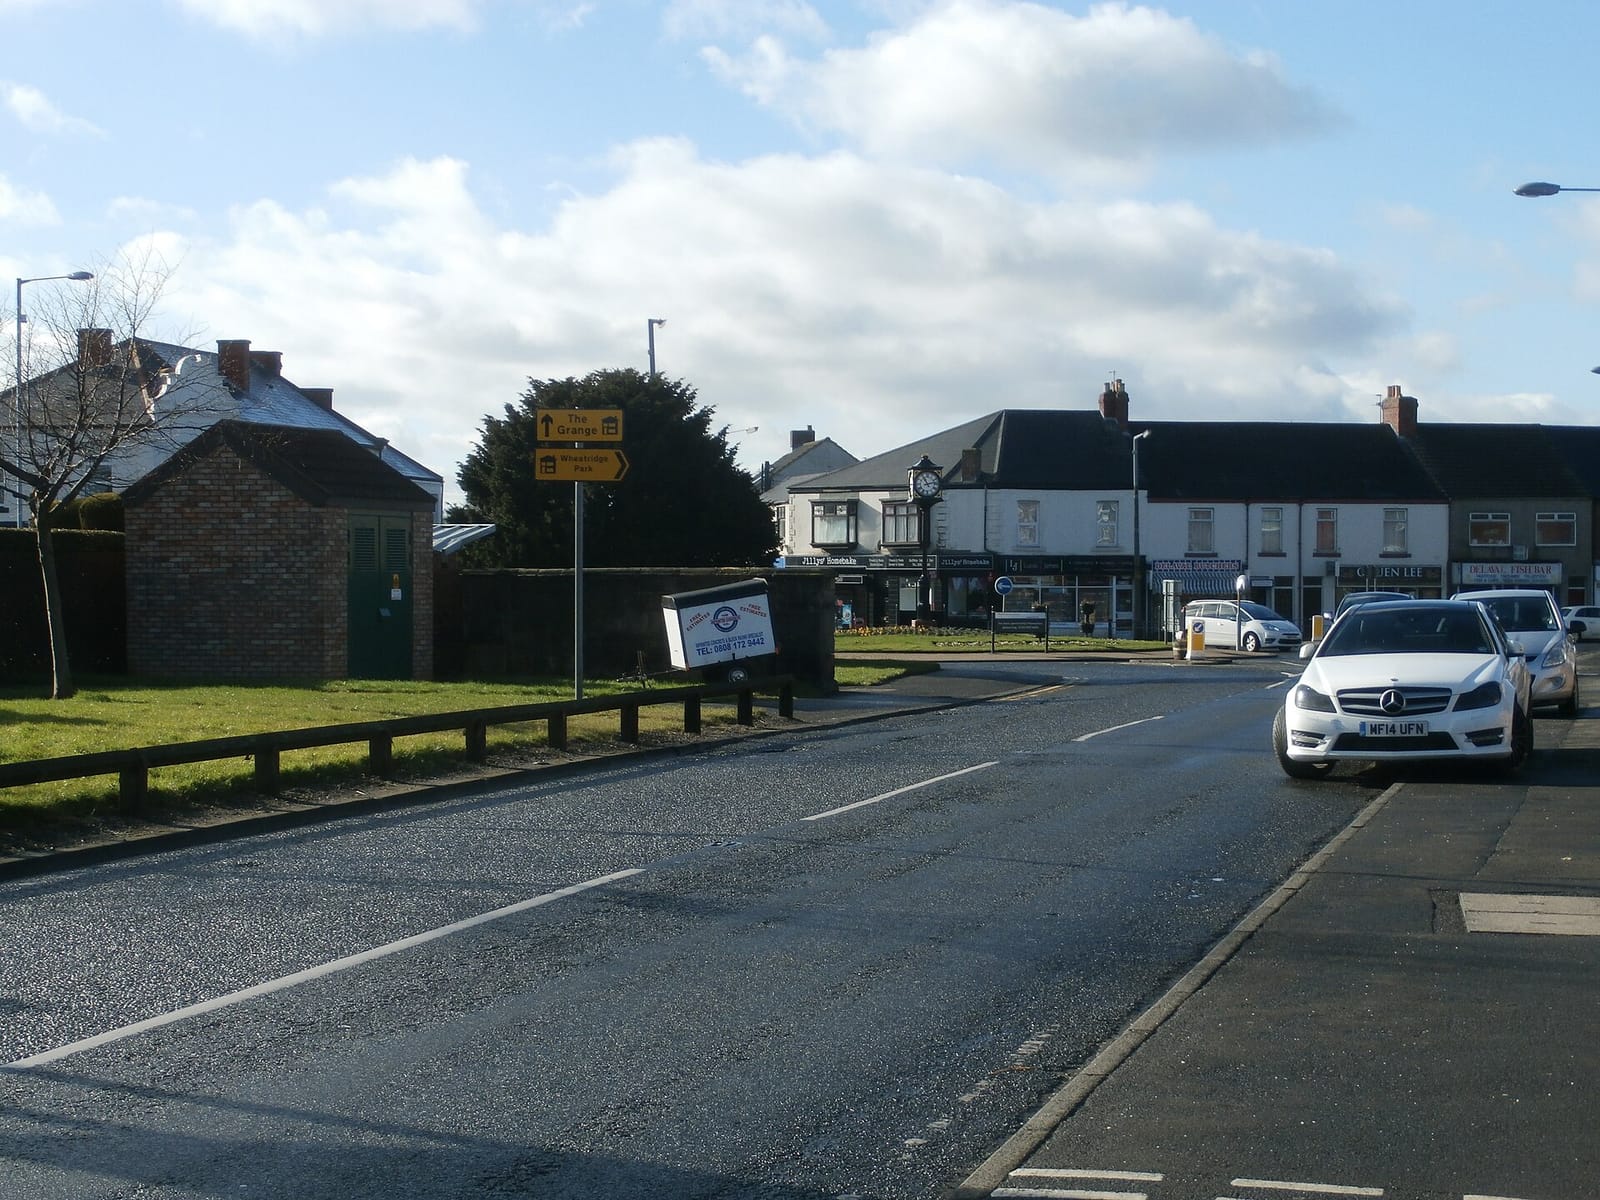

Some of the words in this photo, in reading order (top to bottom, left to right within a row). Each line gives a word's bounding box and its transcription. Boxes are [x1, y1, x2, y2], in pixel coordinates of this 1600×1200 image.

[568, 414, 588, 423] The
[557, 425, 598, 436] Grange
[560, 454, 609, 464] Wheatridge
[826, 556, 857, 565] Homebake
[1404, 567, 1423, 577] LEE
[1511, 565, 1532, 574] FISH
[1534, 565, 1552, 574] BAR
[696, 648, 713, 656] TEL:
[714, 644, 732, 653] 0808
[734, 641, 746, 649] 172
[747, 638, 765, 647] 9442
[1370, 723, 1396, 735] MF14
[1400, 723, 1424, 735] UFN
